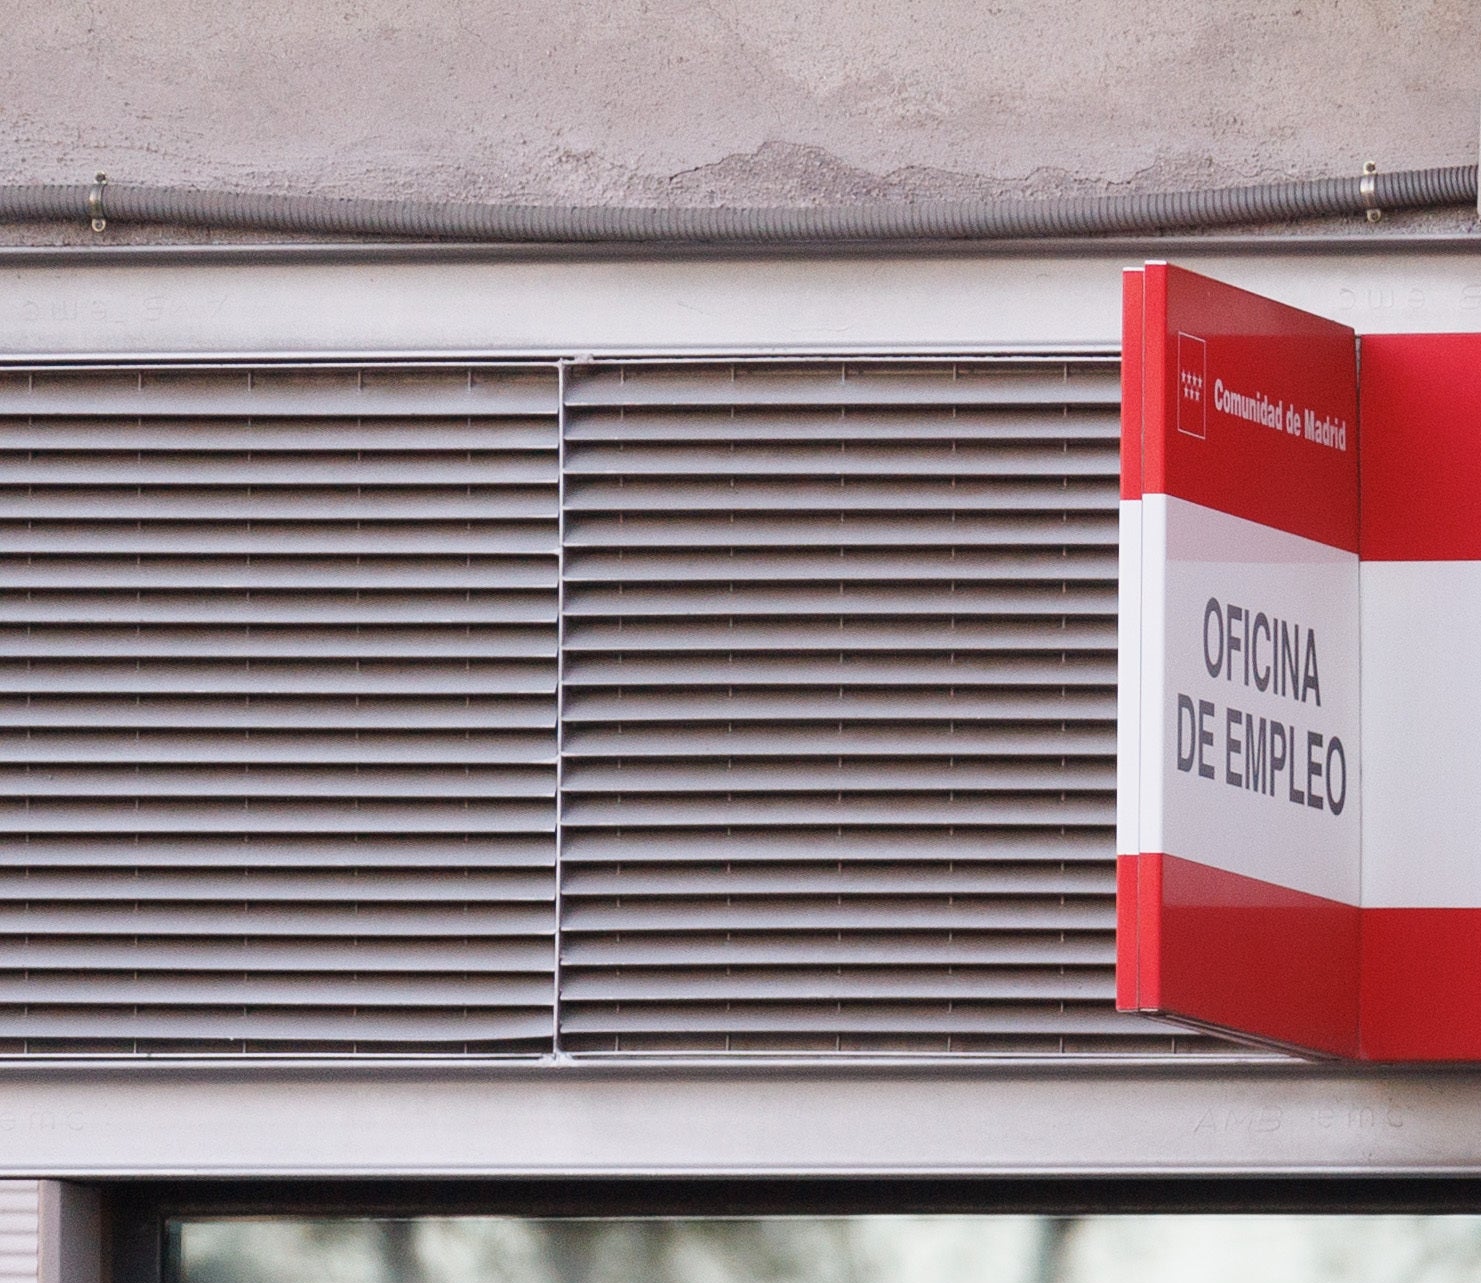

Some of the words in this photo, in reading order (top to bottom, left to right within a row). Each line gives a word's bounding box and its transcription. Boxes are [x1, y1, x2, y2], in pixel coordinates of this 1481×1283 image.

[1214, 377, 1283, 435] Comunidad
[1285, 409, 1302, 438] de
[1303, 412, 1347, 452] Madrid
[1203, 597, 1321, 707] OFICINA
[1177, 693, 1215, 781] DE
[1225, 708, 1347, 817] EMPLEO
